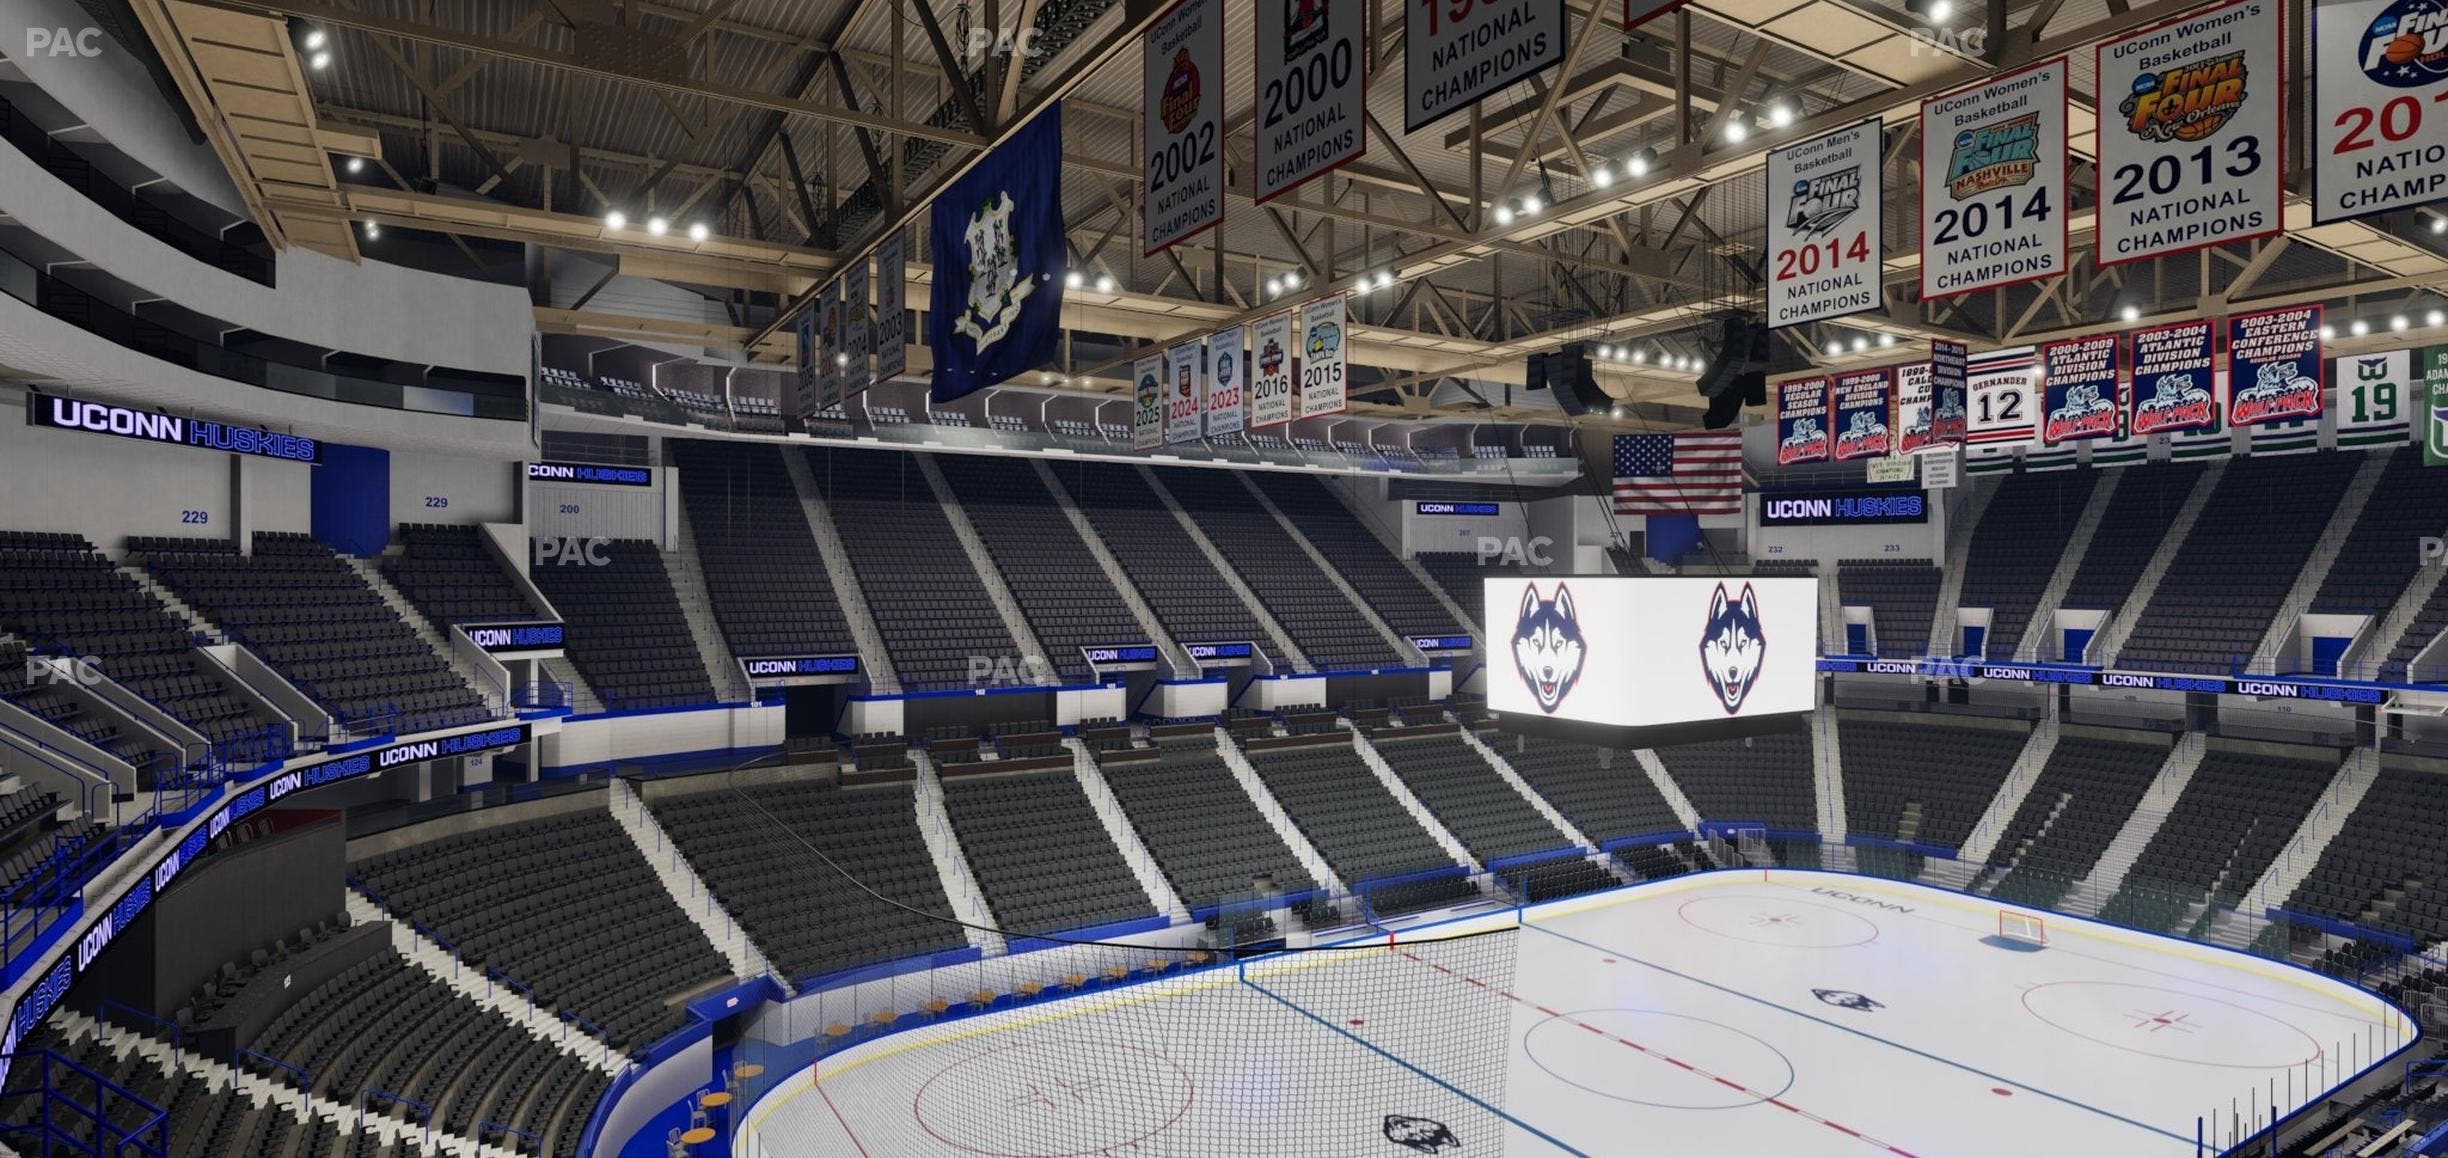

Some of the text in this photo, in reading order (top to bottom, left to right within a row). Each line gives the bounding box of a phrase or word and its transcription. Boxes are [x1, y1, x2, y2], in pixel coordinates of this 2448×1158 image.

[1432, 7, 1536, 73] NATIONAL
[2113, 34, 2170, 59] UConn
[2176, 4, 2261, 39] Women's
[2139, 31, 2231, 70] Basketball
[1264, 38, 1352, 130] 2000
[1422, 32, 1547, 111] CHAMPIONS
[2161, 57, 2241, 96] FINAL
[1934, 71, 2050, 115] UConn Women's
[2131, 78, 2243, 131] FOUR
[1955, 96, 2027, 127] Basketball
[1274, 103, 1346, 154] NATIONAL
[1978, 123, 2033, 150] FINAL
[1150, 121, 1214, 193] 2002
[1267, 129, 1353, 186] CHAMPIONS
[1787, 131, 1860, 161] UConn Men's
[1795, 148, 1851, 174] Basketball
[1951, 139, 2034, 180] FOUR
[2113, 135, 2261, 205] 2013
[1809, 170, 1860, 199] FINAL
[1956, 163, 2029, 191] NASHVILLE
[1158, 176, 1210, 216] NATIONAL
[2340, 174, 2446, 209] CHAMP
[1787, 188, 1860, 228] FOUR
[1933, 186, 2051, 245] 2014
[2130, 188, 2250, 226] NATIONAL
[1152, 199, 1215, 243] CHAMPIONS
[2118, 211, 2263, 253] CHAMPIONS
[1777, 231, 1869, 281] 2014
[1948, 234, 2042, 265] NATIONAL
[1937, 254, 2052, 289] CHAMPIONS
[1788, 273, 1863, 299] NATIONAL
[1780, 292, 1870, 320] CHAMPIONS
[2240, 310, 2311, 328] 2003-2004
[879, 312, 902, 345] 2003
[2138, 325, 2208, 343] 2003-2004
[2232, 330, 2319, 350] CONFERENCE
[2244, 320, 2307, 338] EASTERN
[2049, 338, 2114, 356] 2008-2009
[2051, 349, 2110, 366] ATLANTIC
[2140, 336, 2205, 353] ATLANTIC
[2143, 347, 2201, 364] DIVISION
[2236, 341, 2314, 359] CHAMPIONS
[1304, 361, 1341, 388] 2015
[2046, 369, 2115, 387] CHAMPIONS
[2054, 360, 2106, 375] DIVISION
[2135, 357, 2211, 375] CHAMPIONS
[1211, 387, 1239, 410] 2023
[1255, 375, 1288, 400] 2016
[1308, 388, 1338, 400] NATIONAL
[1171, 397, 1198, 419] 2024
[1258, 400, 1285, 410] NATIONAL
[1305, 400, 1342, 414] CHAMPIONS
[1780, 406, 1827, 419] CHAMPIONS
[1787, 399, 1819, 410] SEASON
[1978, 389, 2023, 424] 12
[2352, 383, 2396, 422] 19
[1136, 406, 1159, 426] 2025
[1256, 410, 1288, 423] CHAMPIONS
[53, 398, 314, 461] UCONN HUSKIES
[425, 496, 448, 508] 229
[1420, 504, 1454, 513] UCONN
[1767, 496, 1922, 518] UCONN HUSKIES
[182, 510, 208, 524] 229
[1768, 545, 1782, 553] 232
[1883, 544, 1900, 552] 233
[469, 629, 511, 646] UCONN
[1088, 649, 1118, 661] UCONN
[1189, 646, 1216, 657] UCONN
[749, 660, 797, 674] UCONN
[1866, 663, 1916, 674] UCONN
[1983, 667, 2030, 680] UCONN
[2102, 674, 2154, 687] UCONN
[2238, 682, 2297, 697] UCONN
[379, 727, 521, 767] UCONN HUSKIES
[269, 755, 370, 800] UCONN HUSKIES
[209, 806, 230, 839] UCONN
[155, 849, 180, 892] UCONN
[1811, 888, 1915, 913] UCONN
[78, 912, 113, 972] UCONN
